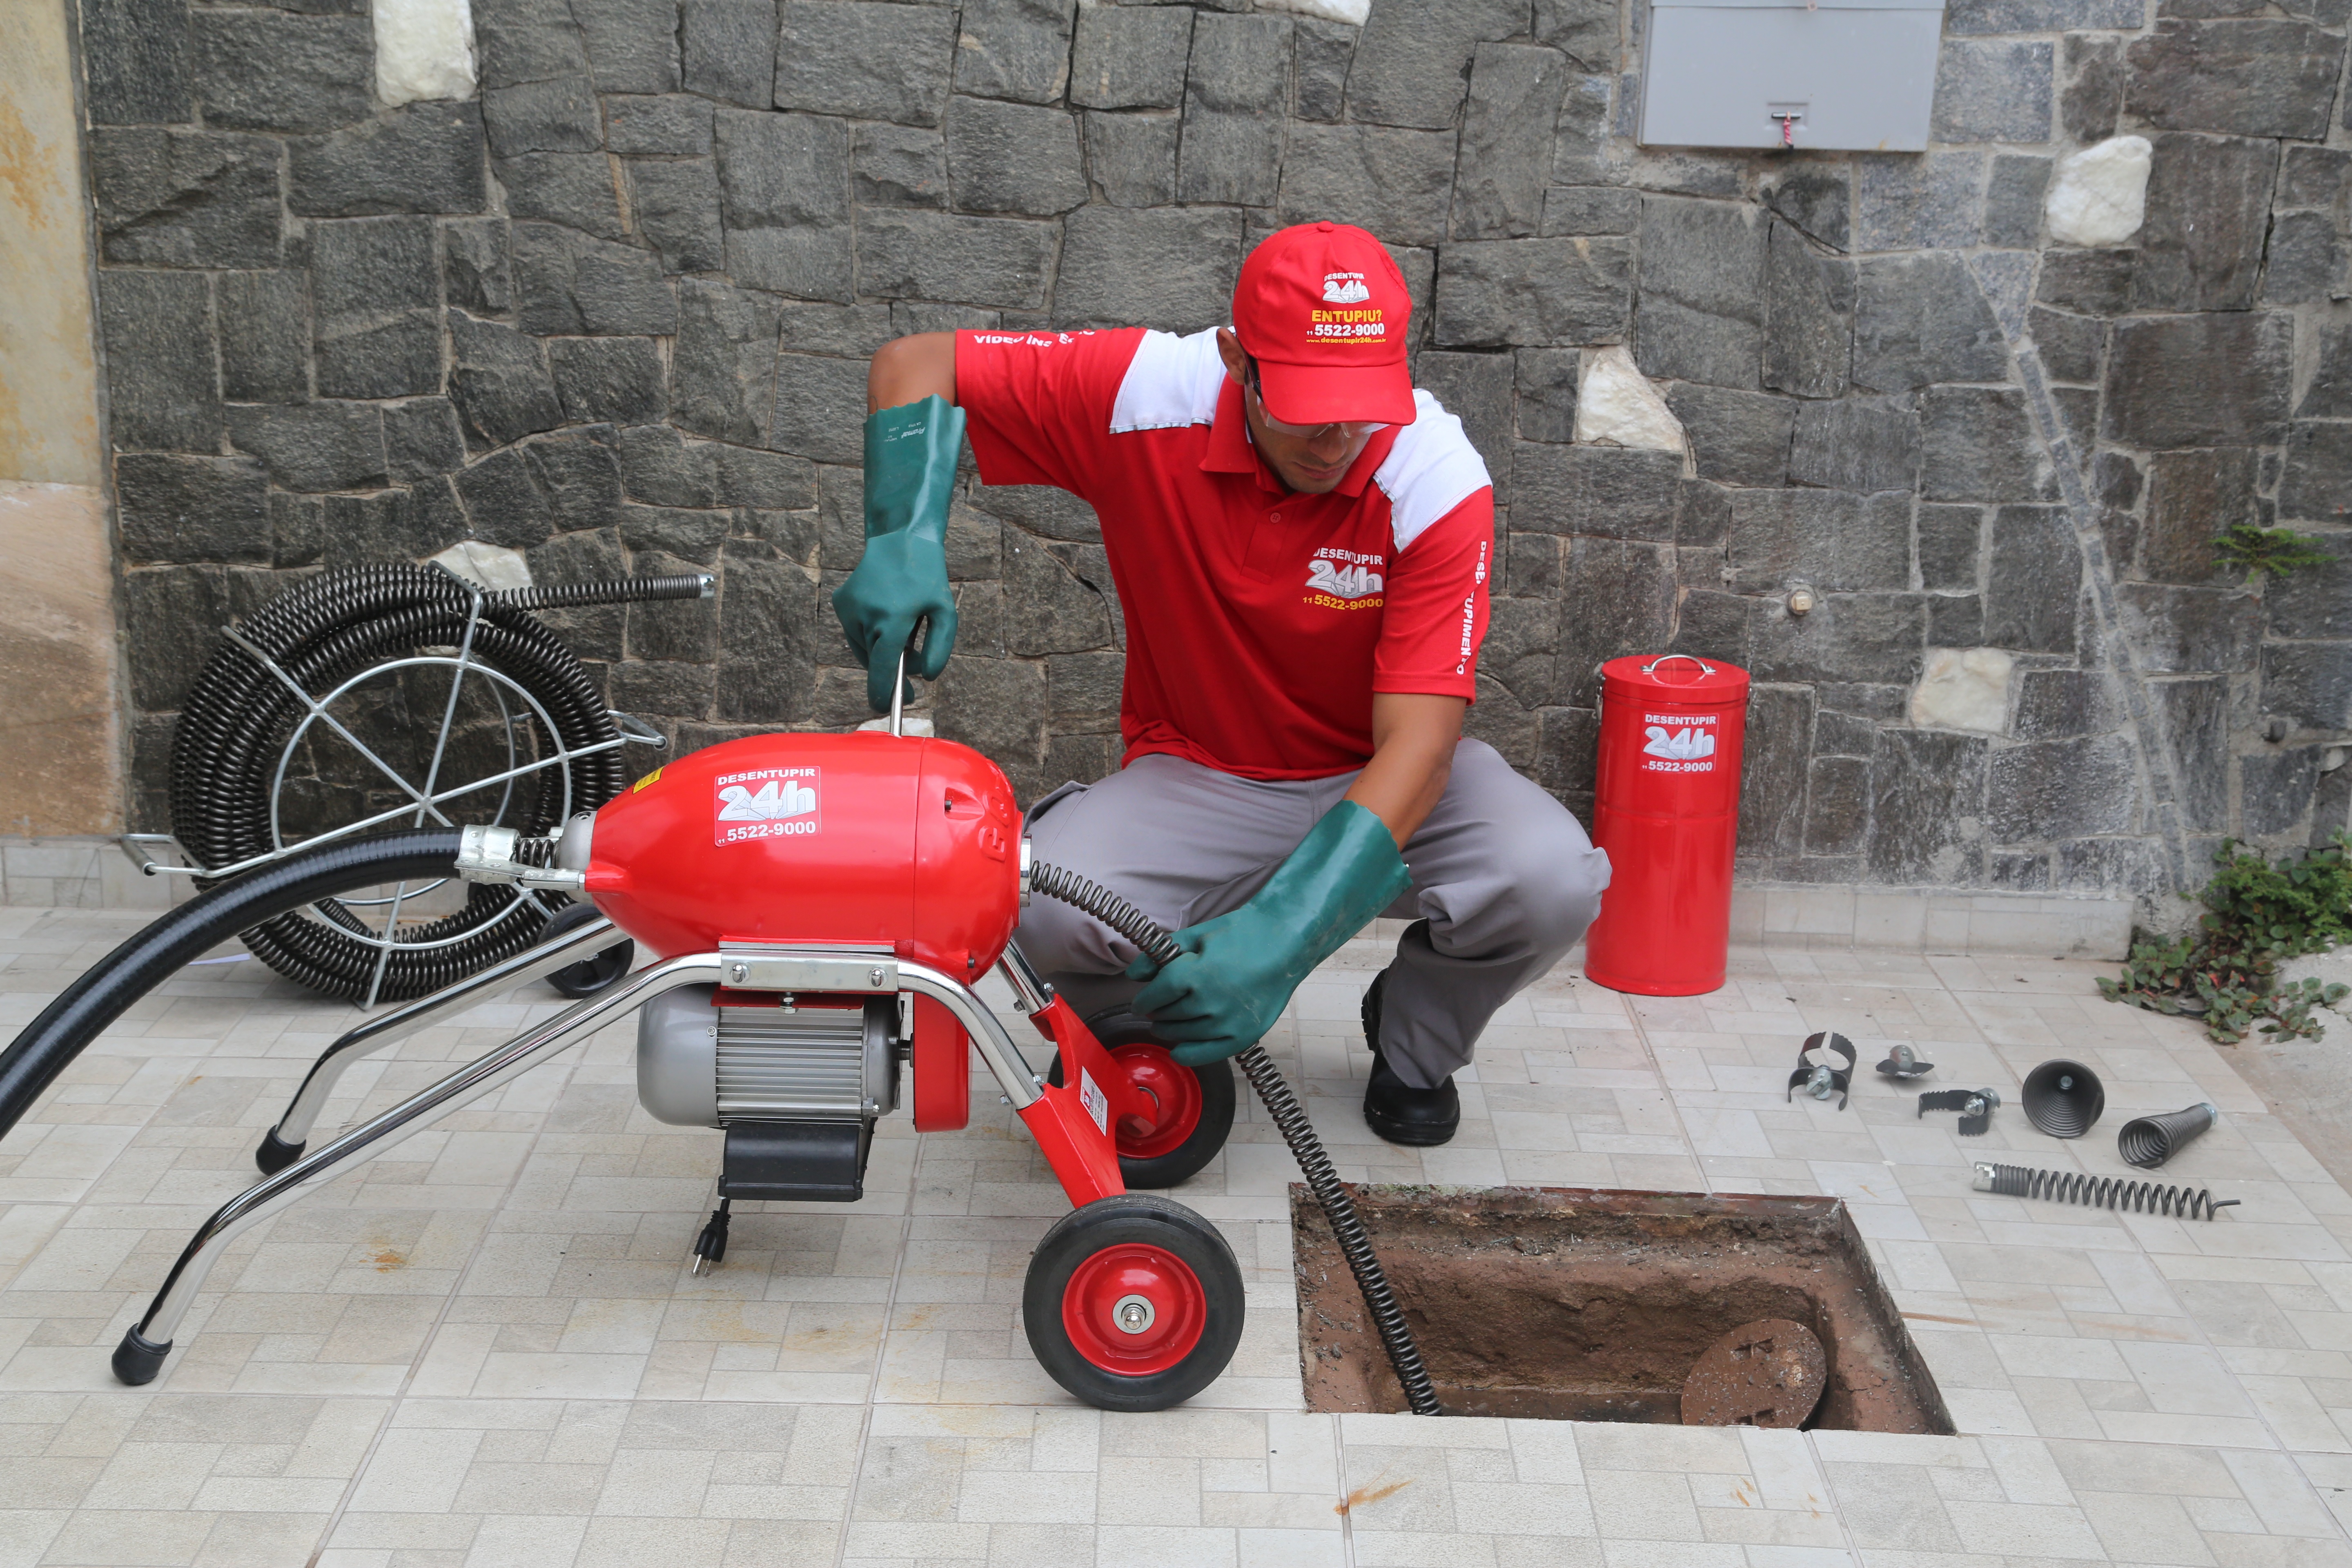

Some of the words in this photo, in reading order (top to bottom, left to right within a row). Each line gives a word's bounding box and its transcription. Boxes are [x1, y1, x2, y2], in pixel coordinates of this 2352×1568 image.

[1324, 272, 1364, 281] DESENTUPIR
[1322, 280, 1370, 303] 24h
[1312, 309, 1382, 322] ENTUPIU?
[1315, 323, 1385, 336] 5522-9000
[1305, 559, 1383, 599] 24h
[1314, 595, 1383, 610] 5522-9000
[1645, 714, 1716, 725] DESENTUPIR
[1643, 726, 1715, 760] 24h
[1648, 761, 1713, 772] 5522-9000
[718, 768, 815, 786] DESENTUPIR
[718, 780, 816, 821] 24h
[727, 821, 816, 842] 5522-9000
